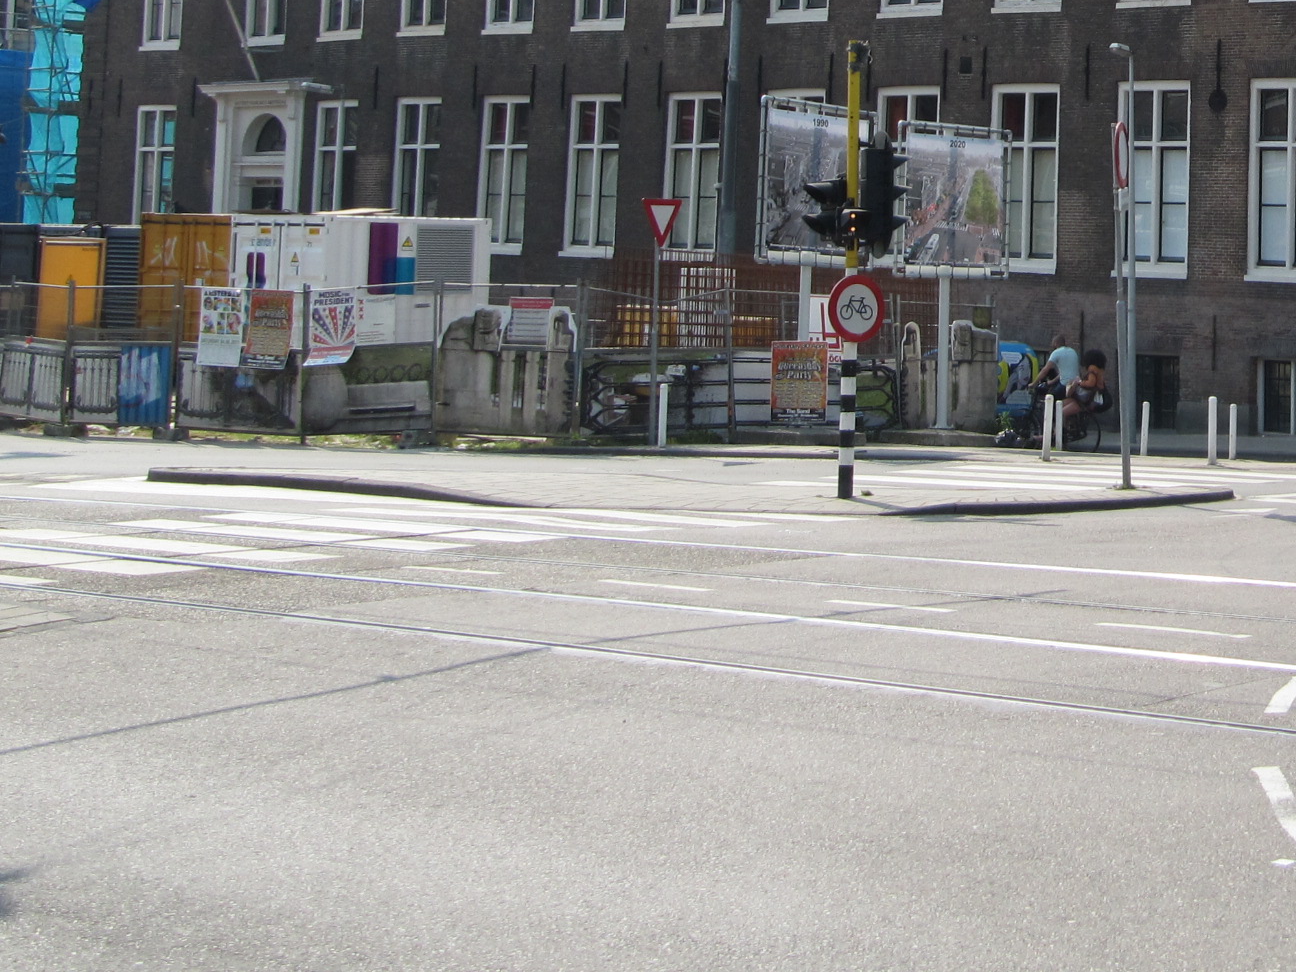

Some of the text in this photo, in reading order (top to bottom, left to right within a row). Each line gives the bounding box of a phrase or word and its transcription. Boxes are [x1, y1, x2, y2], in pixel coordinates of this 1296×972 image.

[812, 118, 829, 128] 1990
[949, 139, 966, 149] 2020
[313, 297, 354, 307] PRESIDENT
